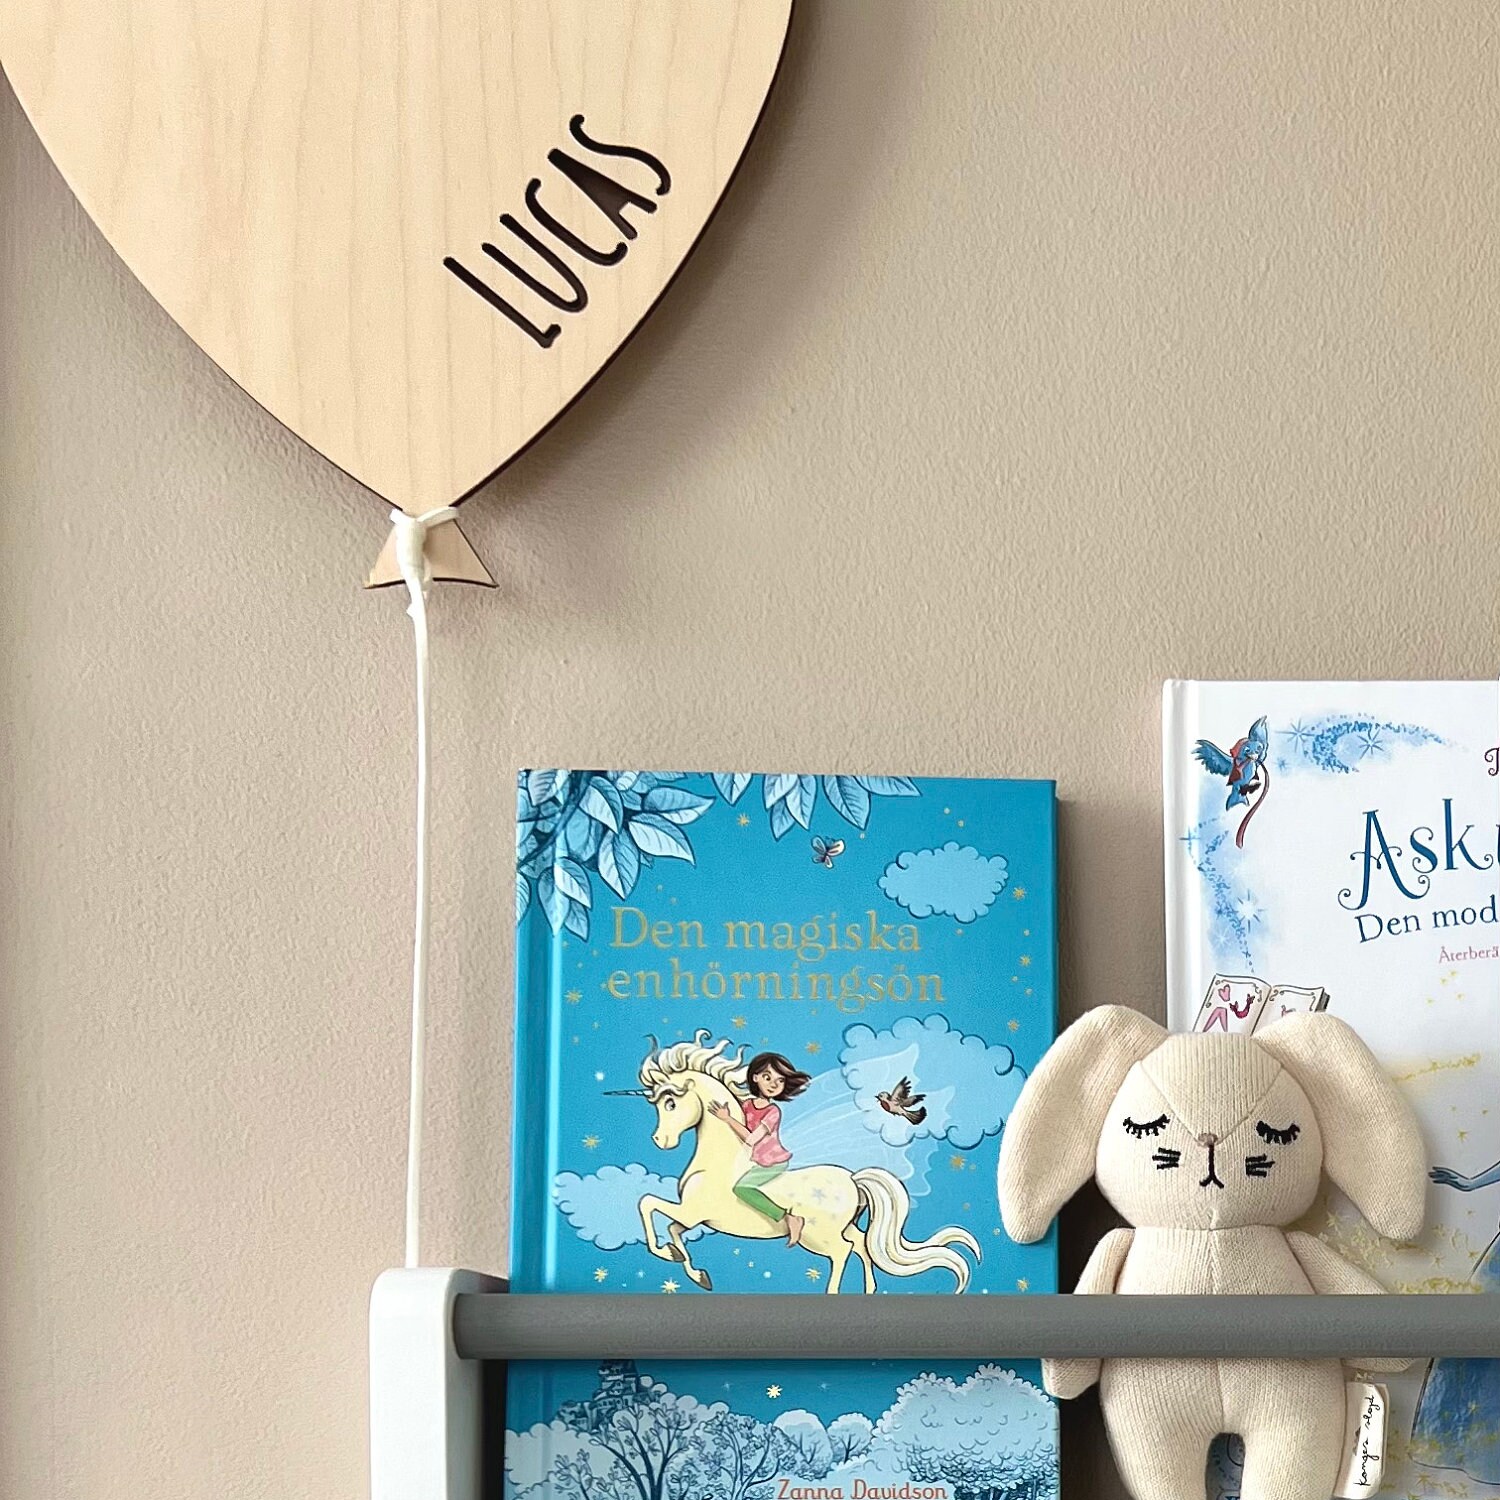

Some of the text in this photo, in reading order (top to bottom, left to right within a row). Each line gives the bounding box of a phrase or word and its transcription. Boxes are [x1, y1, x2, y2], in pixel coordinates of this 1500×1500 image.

[442, 113, 672, 349] LUCAS
[1337, 797, 1500, 911] Ask
[609, 905, 922, 963] Den magiska
[1354, 912, 1422, 944] Den
[606, 957, 946, 1015] enhörningsön
[777, 1478, 949, 1500] Zanna Davidson
